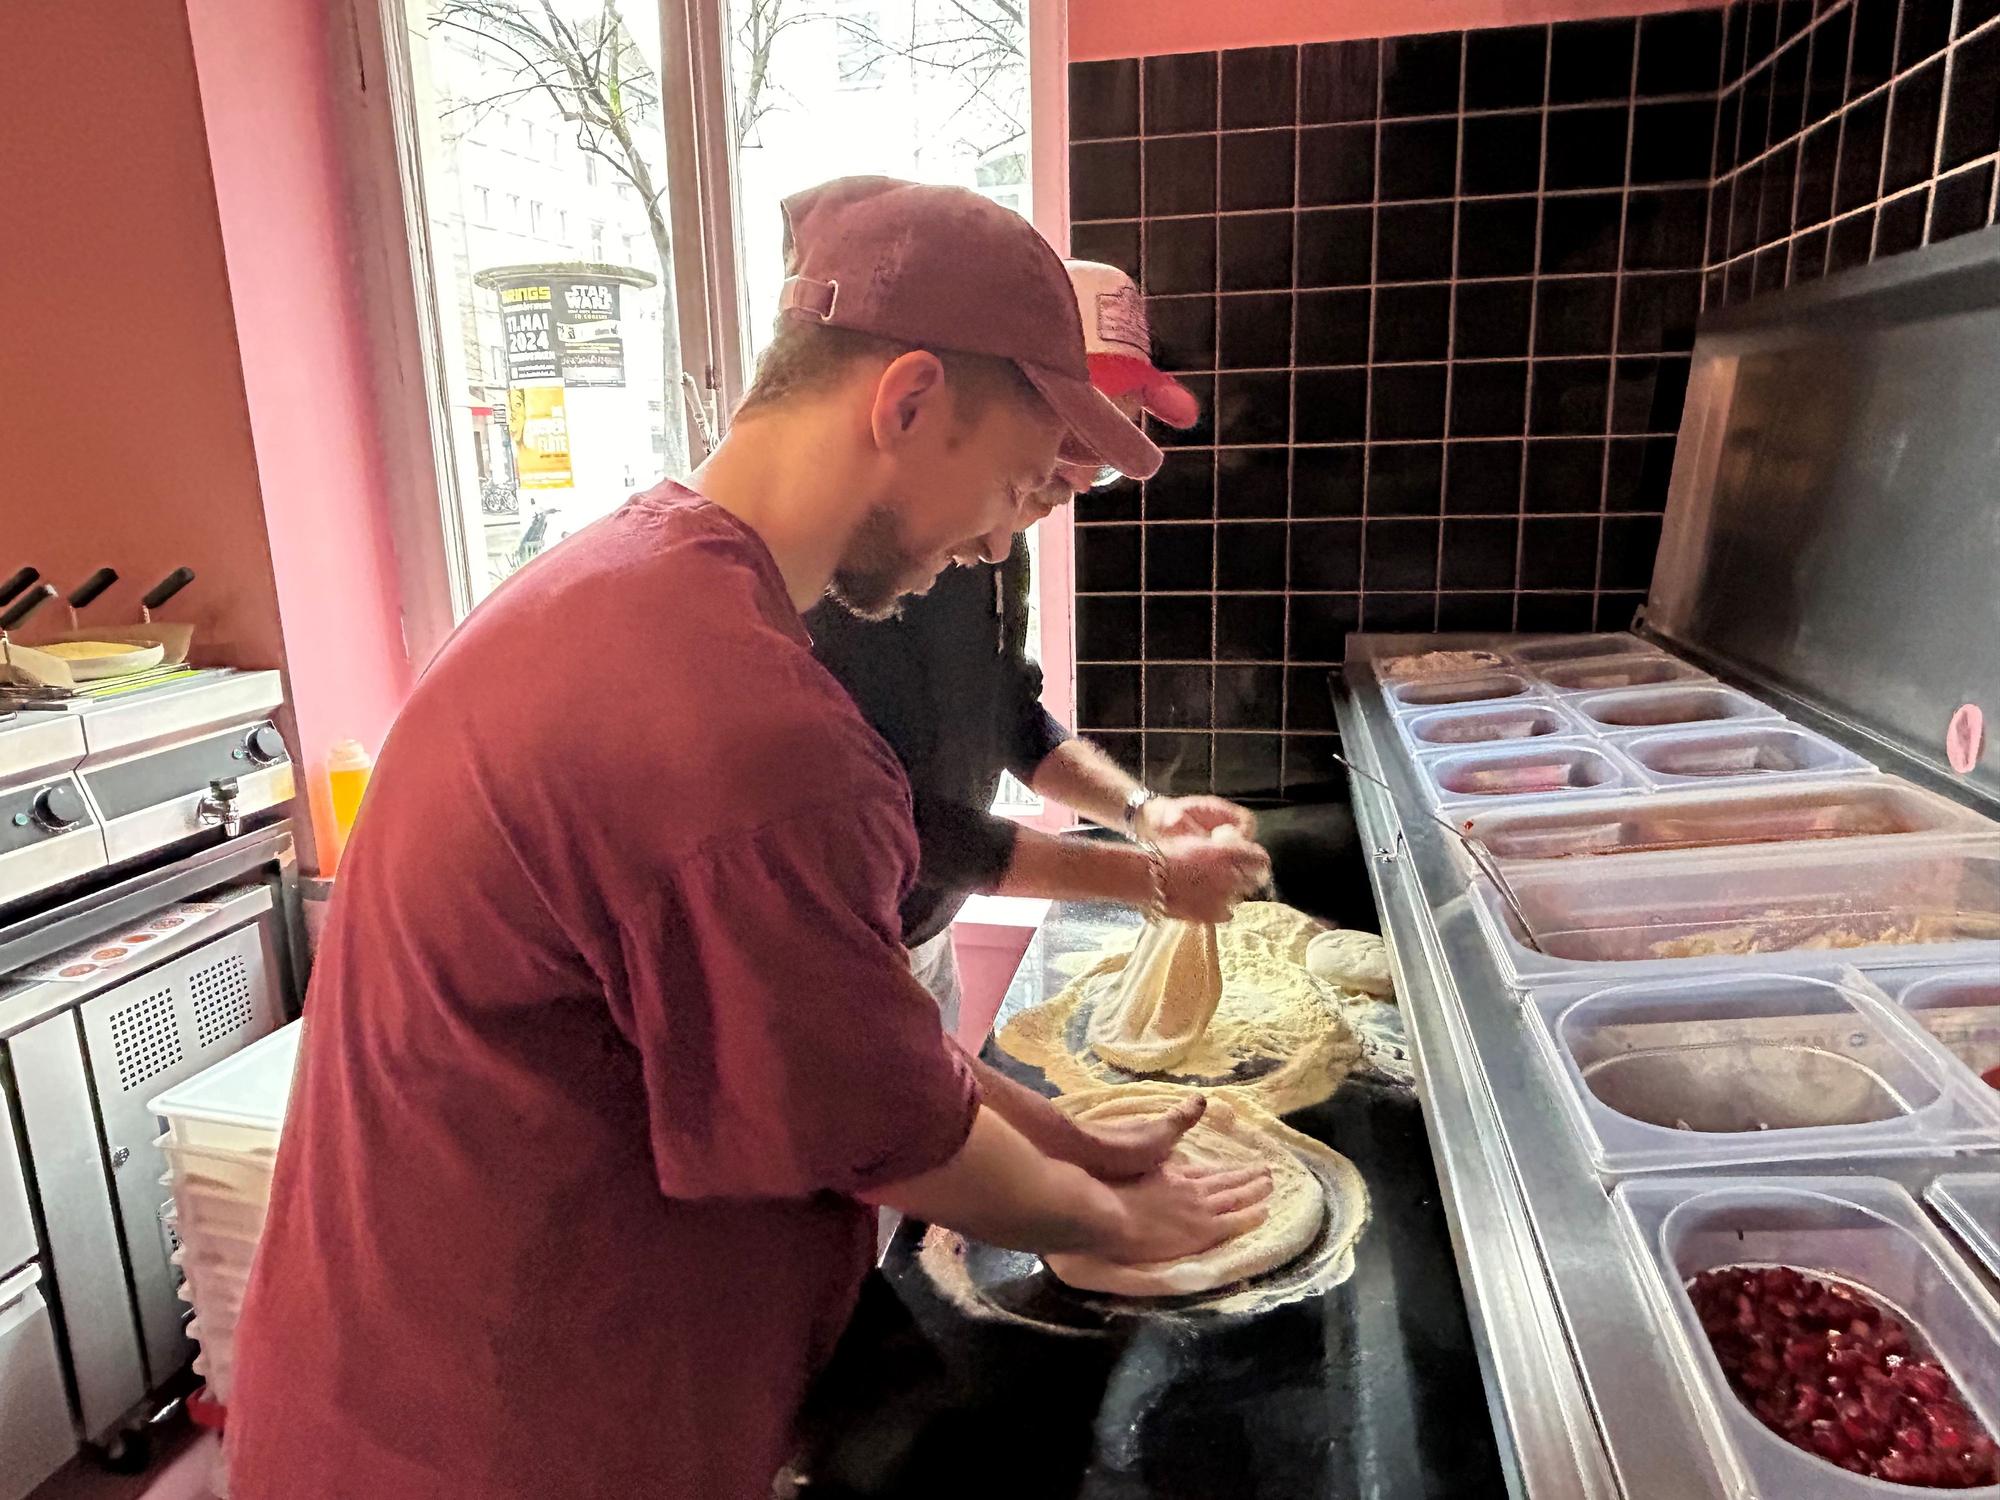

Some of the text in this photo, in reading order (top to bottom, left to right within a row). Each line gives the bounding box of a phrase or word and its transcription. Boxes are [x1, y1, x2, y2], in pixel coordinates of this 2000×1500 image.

[565, 291, 613, 310] WARS
[571, 285, 608, 298] STAR
[509, 330, 549, 353] 2024
